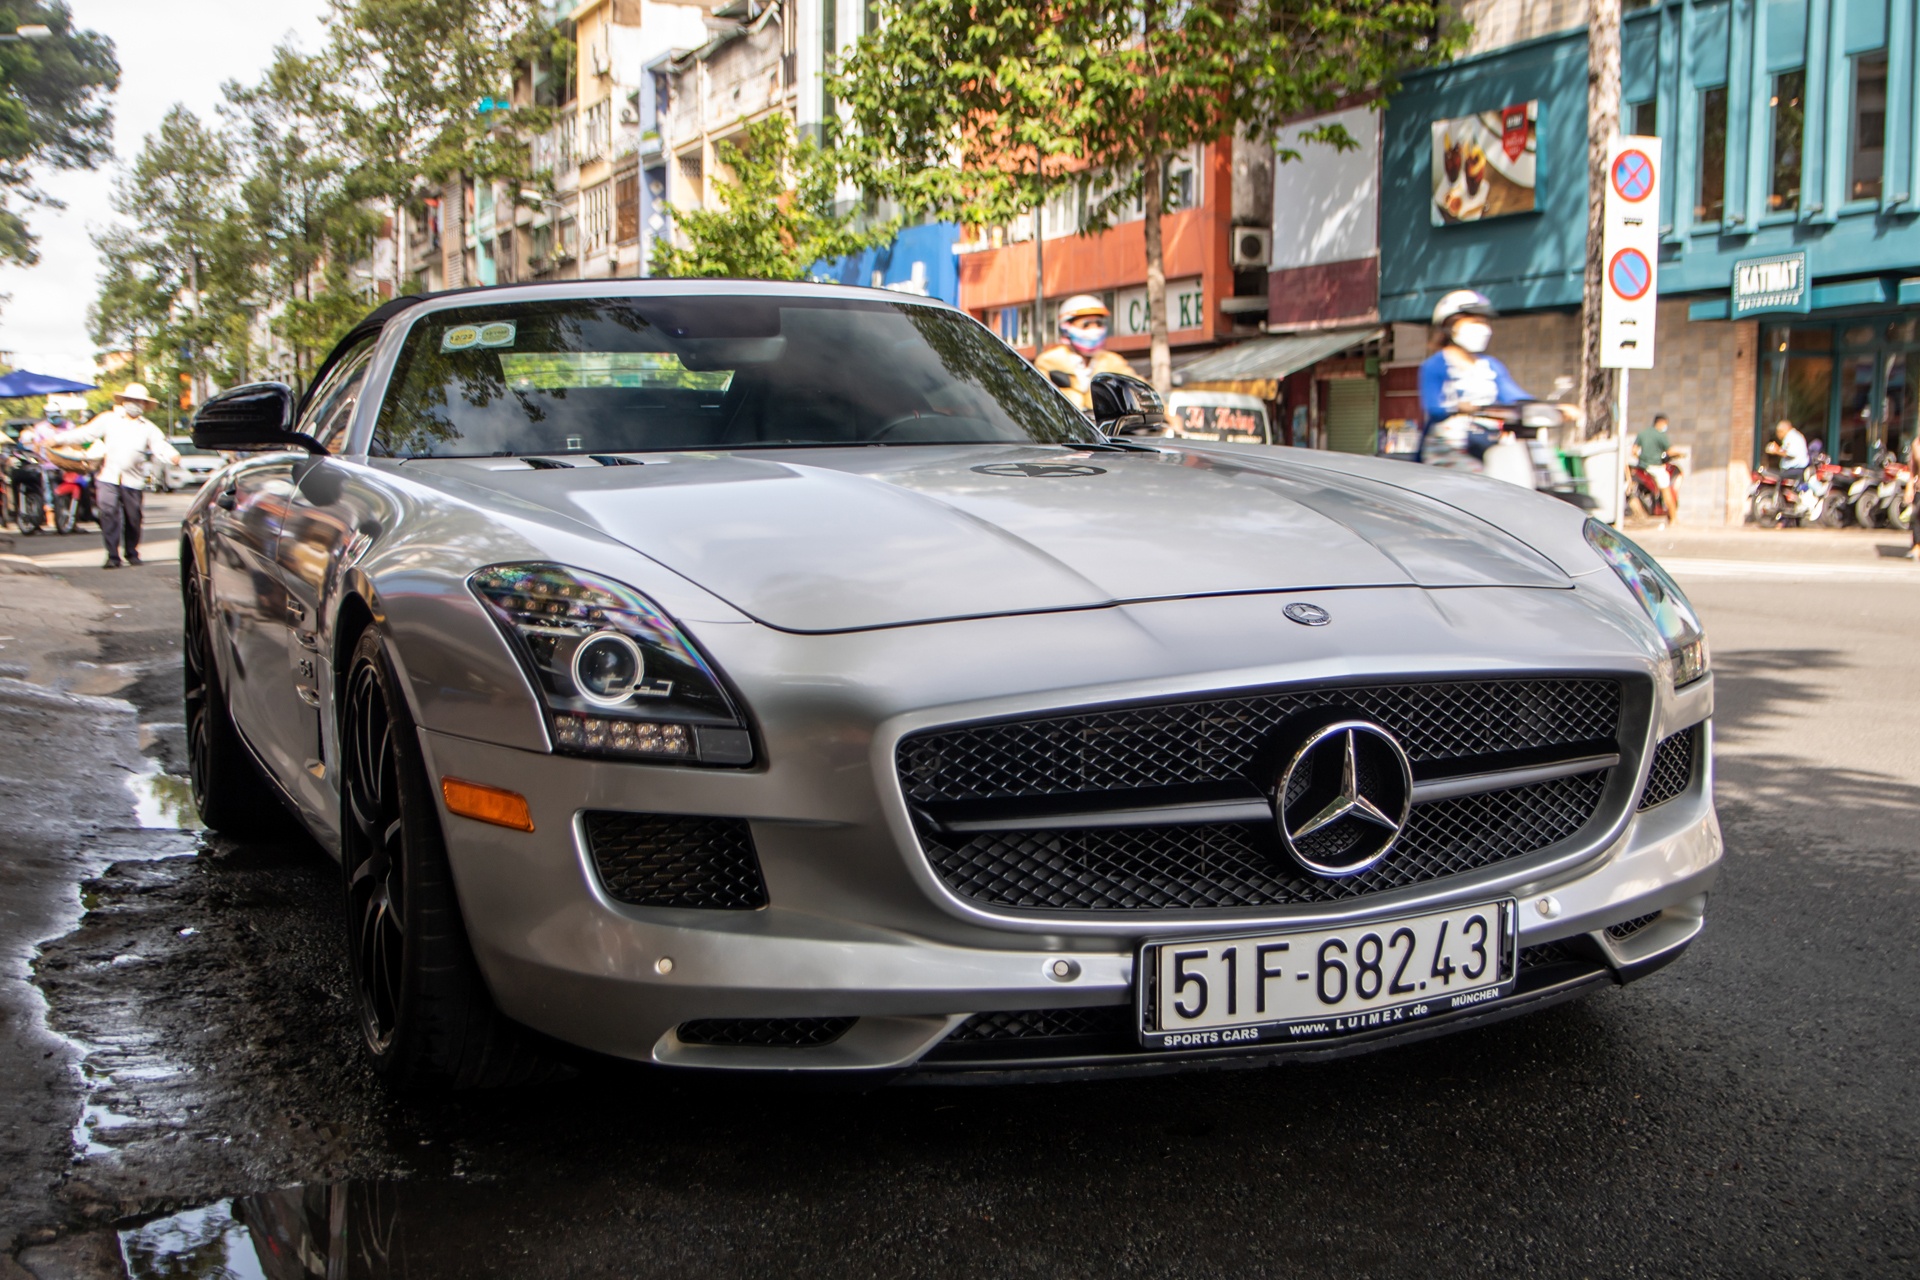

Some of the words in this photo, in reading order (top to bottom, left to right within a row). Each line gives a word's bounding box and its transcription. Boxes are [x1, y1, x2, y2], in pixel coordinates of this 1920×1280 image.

[1174, 914, 1488, 1019] 51F-682.43
[1451, 987, 1499, 1007] MÜNCHEN
[1164, 1031, 1219, 1046] SPORTS
[1222, 1028, 1259, 1041] CARS
